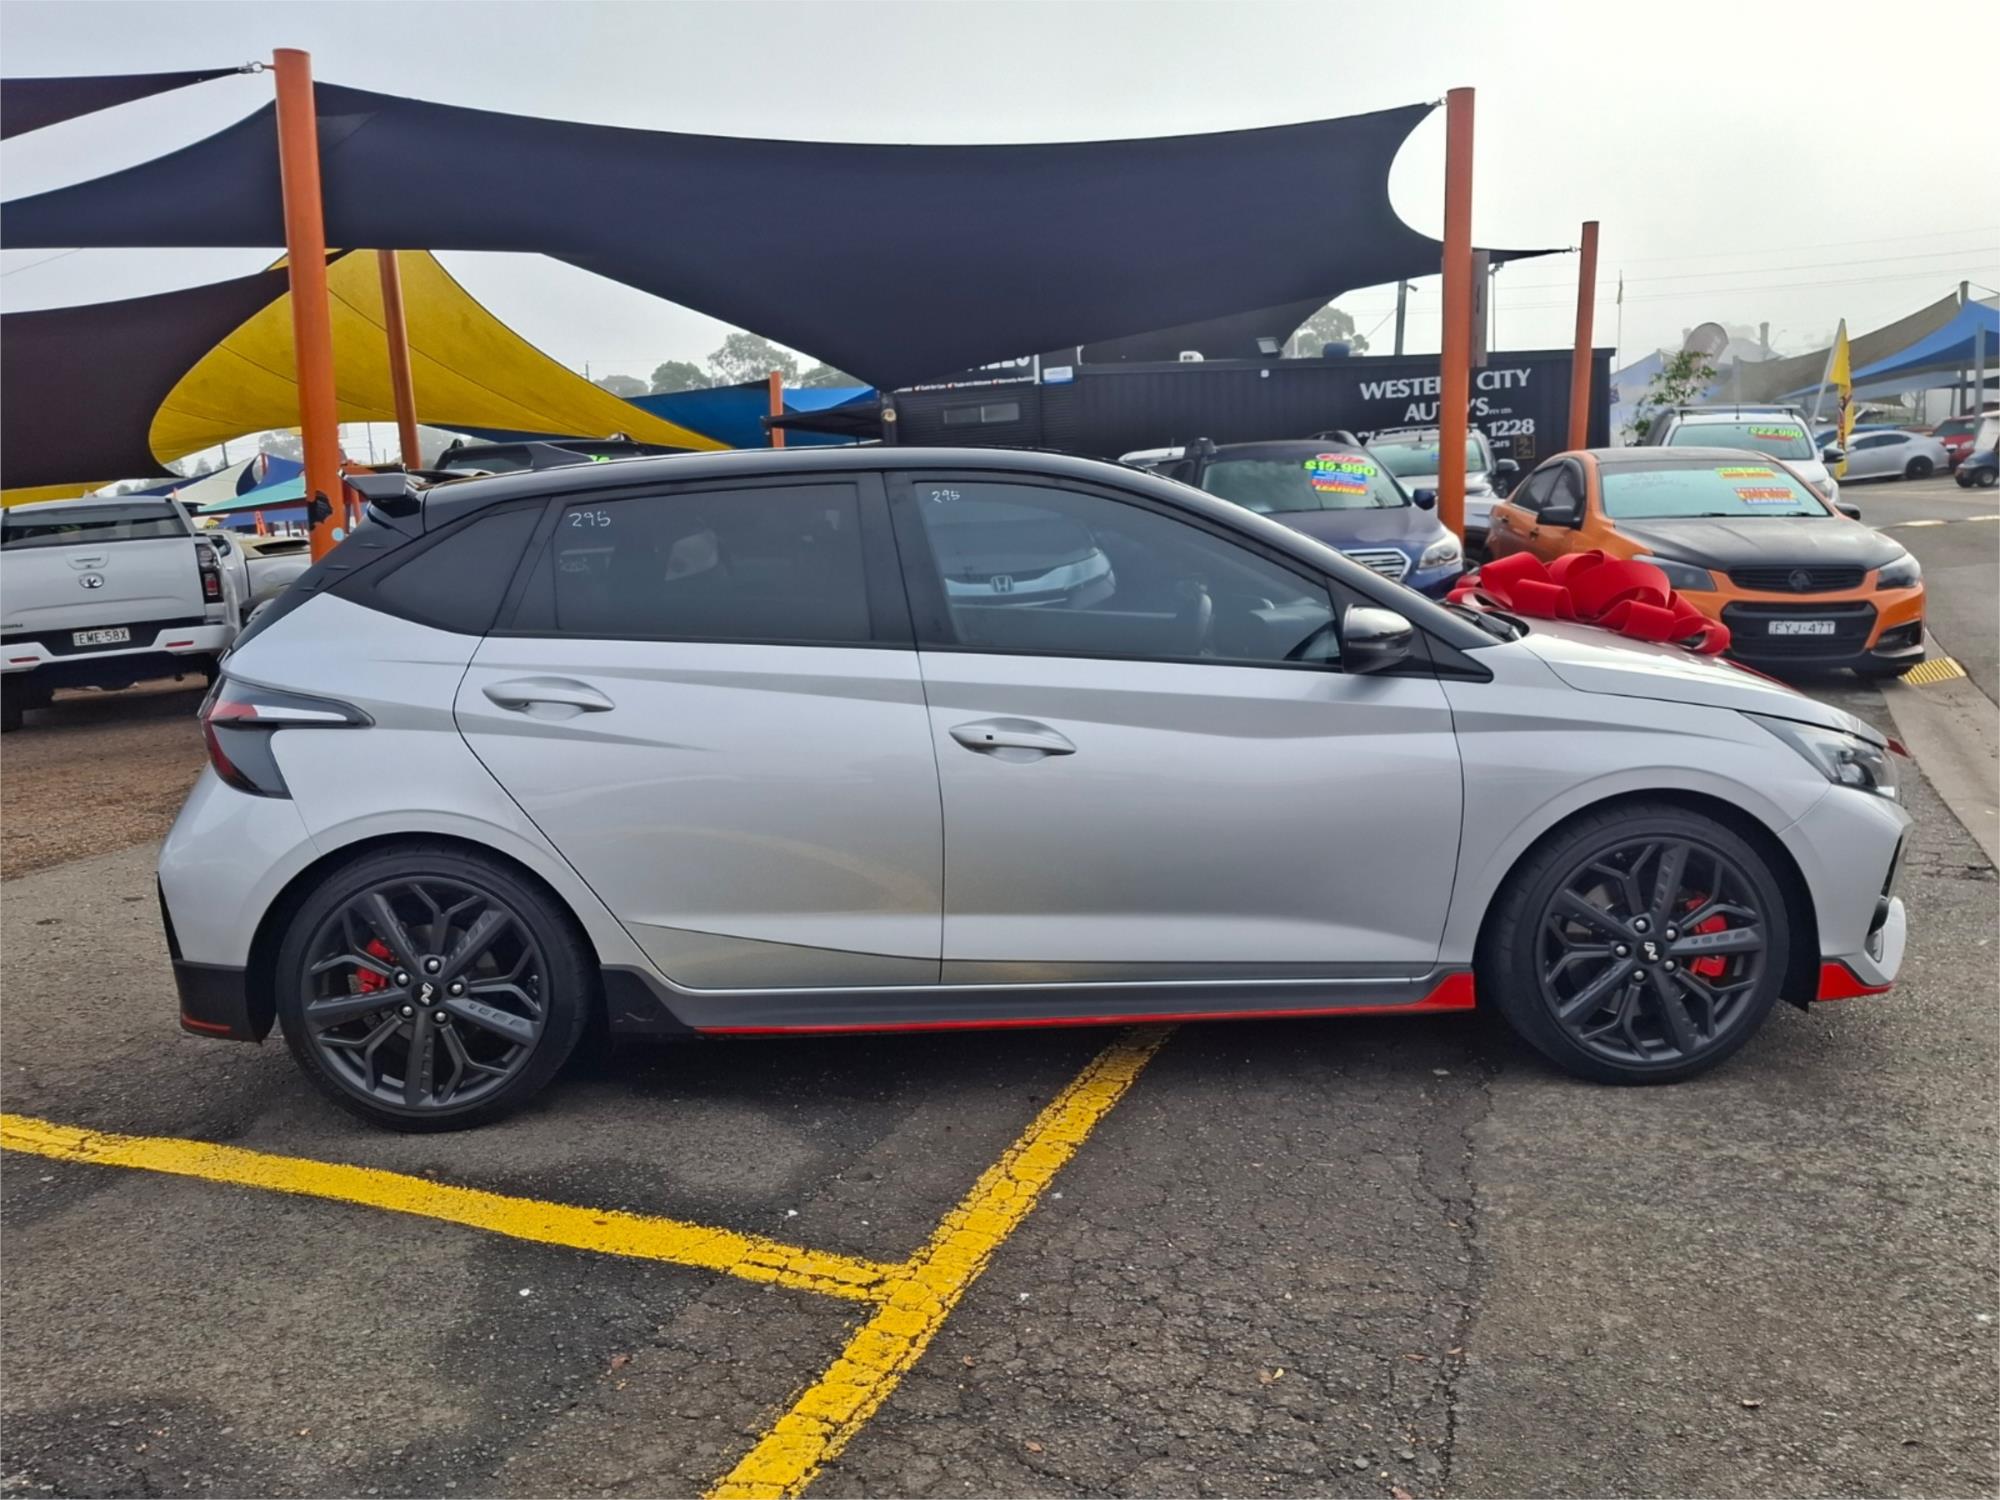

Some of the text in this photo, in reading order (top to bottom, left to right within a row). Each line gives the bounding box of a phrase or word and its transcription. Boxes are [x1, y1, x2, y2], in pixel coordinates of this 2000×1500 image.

[1476, 368, 1531, 390] CITY
[1404, 397, 1489, 421] AU'S
[1487, 418, 1535, 437] 1228
[1488, 439, 1510, 448] Cars
[932, 489, 961, 503] 295
[568, 511, 611, 527] 295
